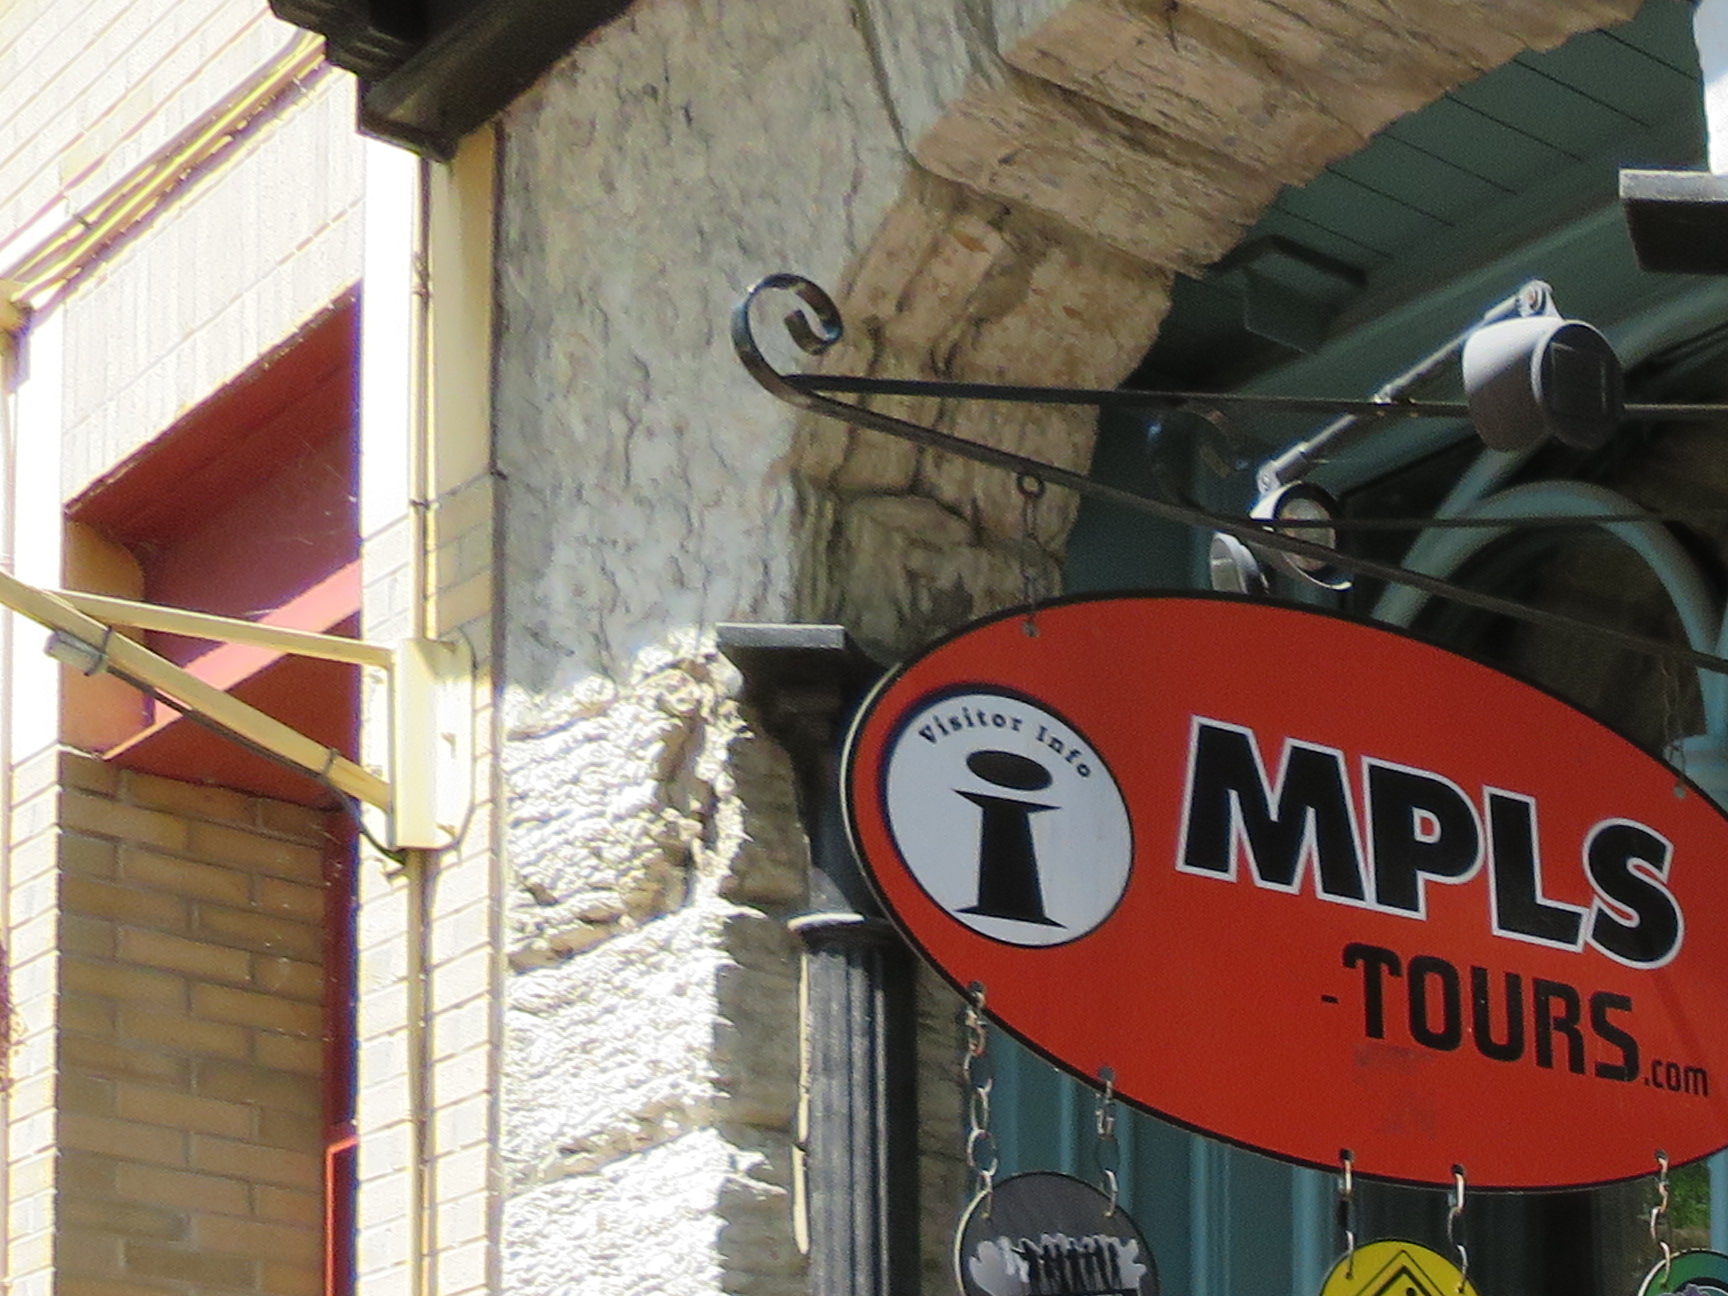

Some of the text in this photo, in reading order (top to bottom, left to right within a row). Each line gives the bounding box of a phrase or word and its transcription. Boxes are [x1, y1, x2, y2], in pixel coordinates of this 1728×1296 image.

[918, 706, 1091, 778] Visitor Info
[1176, 715, 1684, 969] MPLS
